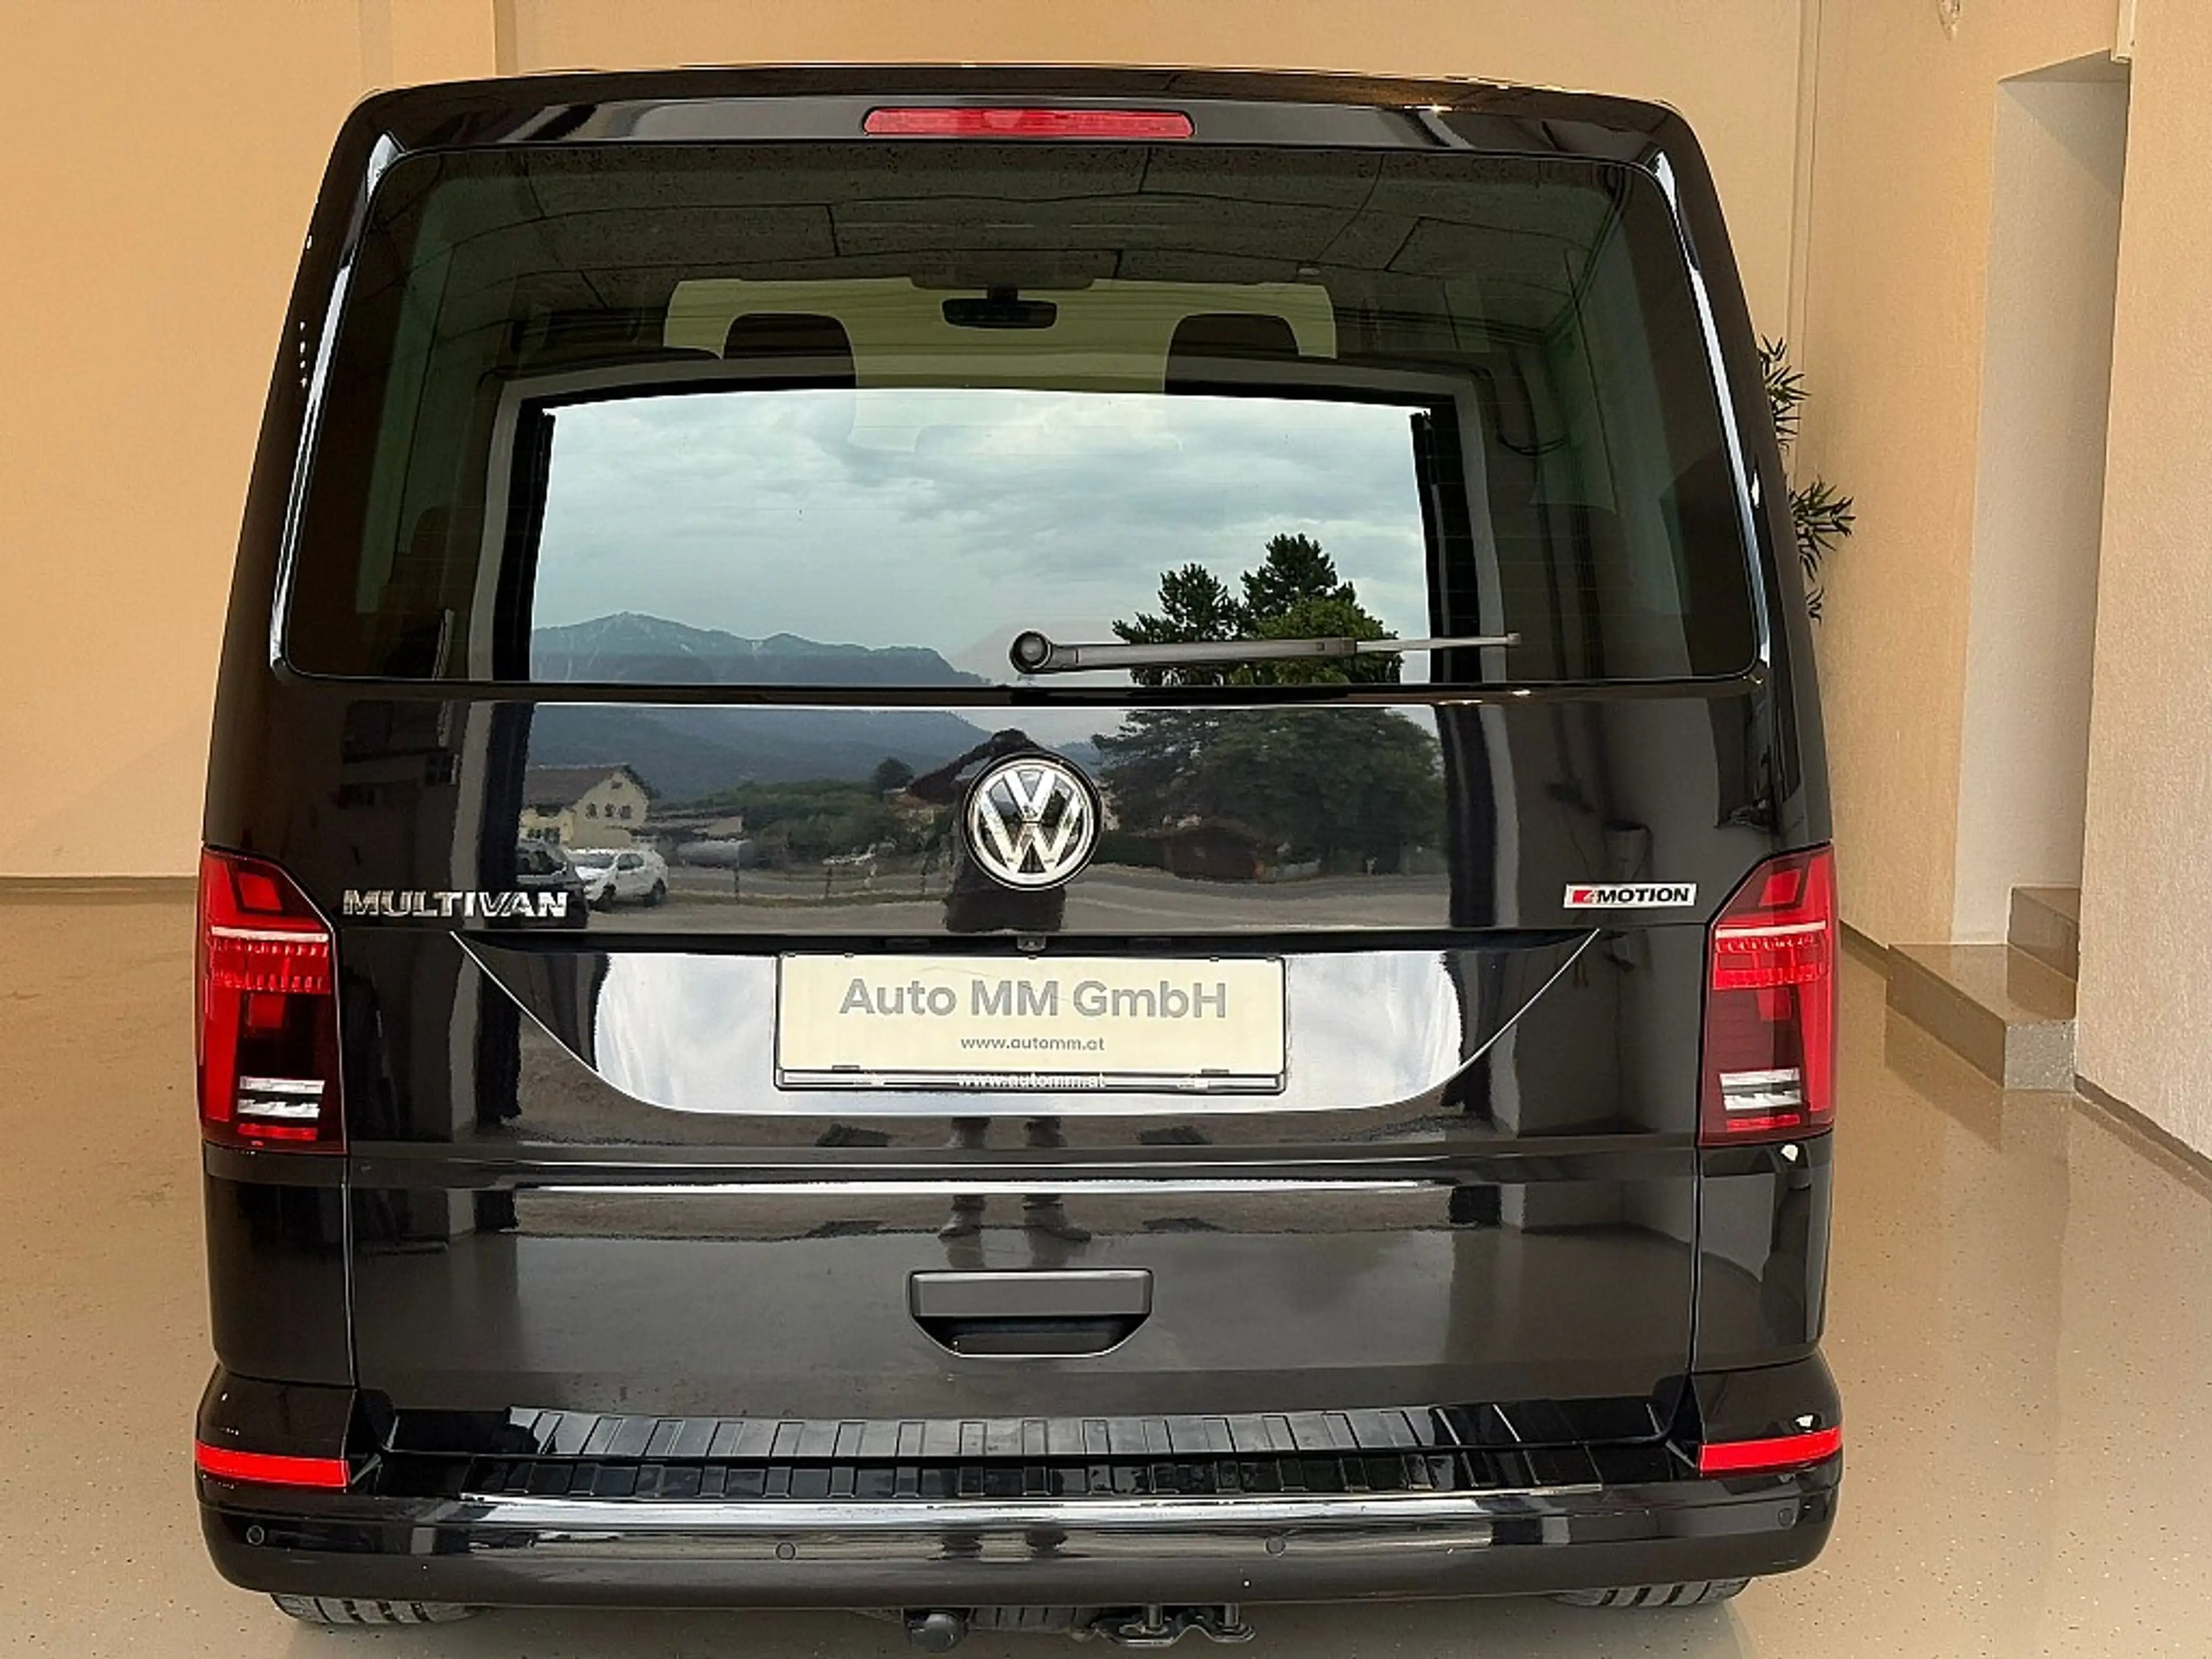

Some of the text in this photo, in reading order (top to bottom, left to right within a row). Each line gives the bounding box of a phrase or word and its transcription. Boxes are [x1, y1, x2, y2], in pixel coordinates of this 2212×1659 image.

[343, 889, 569, 917] MULTIVAN
[839, 978, 1227, 1019] Auto MM GmbH
[960, 1037, 1105, 1051] www.automm.at
[957, 1072, 1106, 1088] www.automm.at
